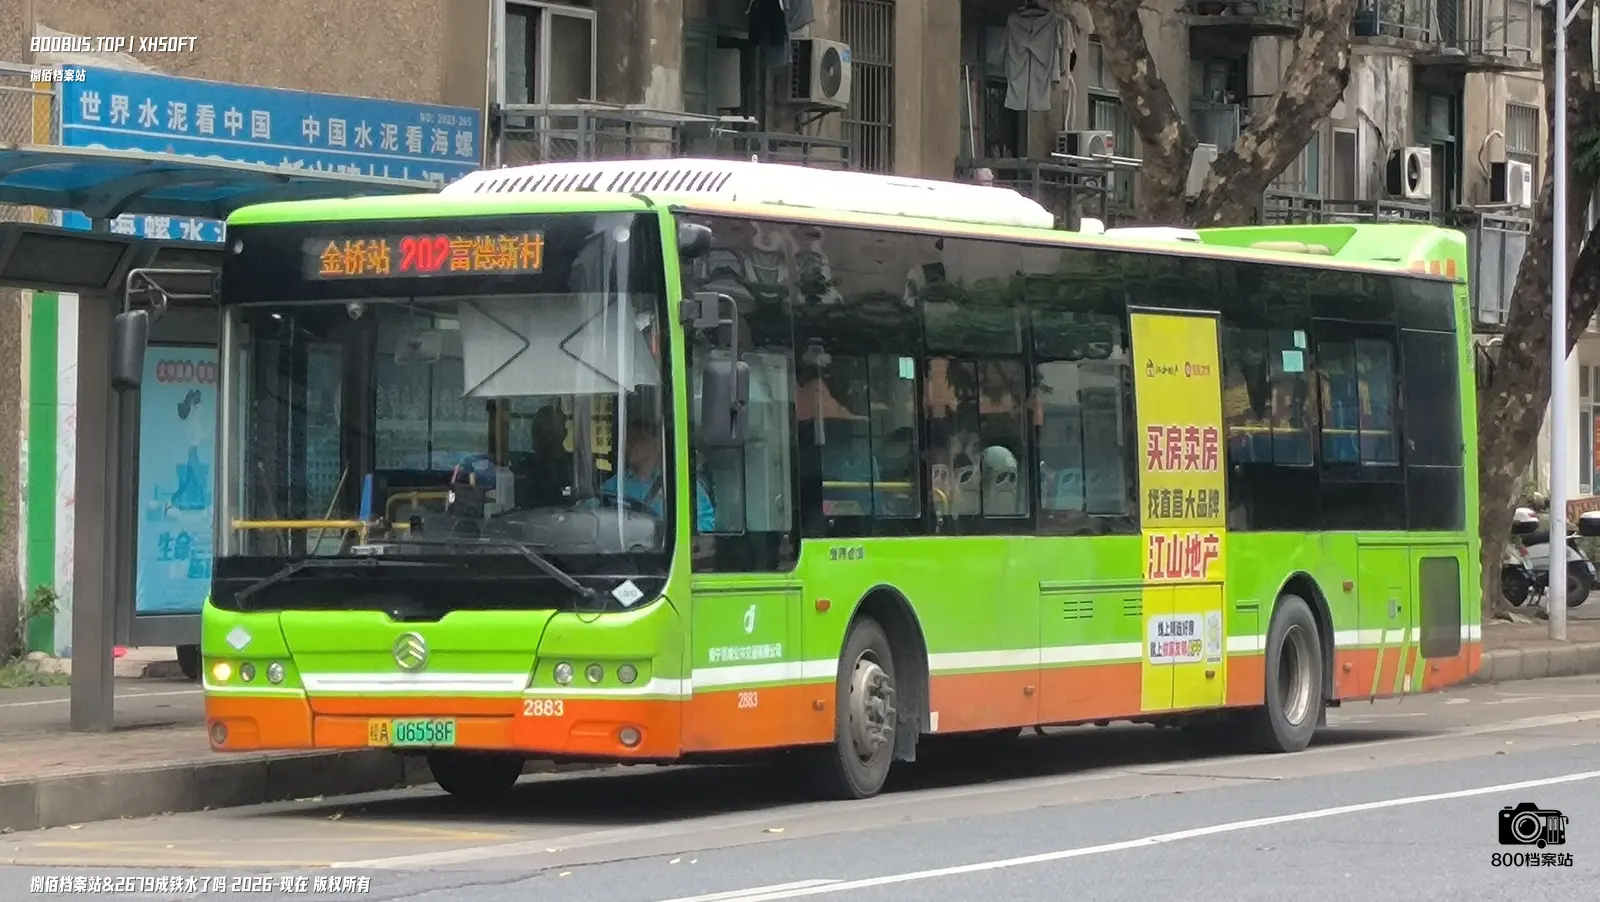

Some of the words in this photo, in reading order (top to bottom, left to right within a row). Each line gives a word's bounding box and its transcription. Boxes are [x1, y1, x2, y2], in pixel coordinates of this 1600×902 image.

[80, 90, 271, 139] 世界水泥看中国
[302, 119, 473, 157] 中国水泥看海螺
[110, 213, 226, 242] 海螺水
[319, 240, 391, 275] 金桥站
[450, 233, 545, 271] 富德新村
[1146, 425, 1218, 471] 买房卖房
[1147, 489, 1220, 519] 找直营大品牌
[1148, 533, 1220, 580] 江山地产
[523, 699, 565, 717] 2883
[737, 691, 759, 709] 2883
